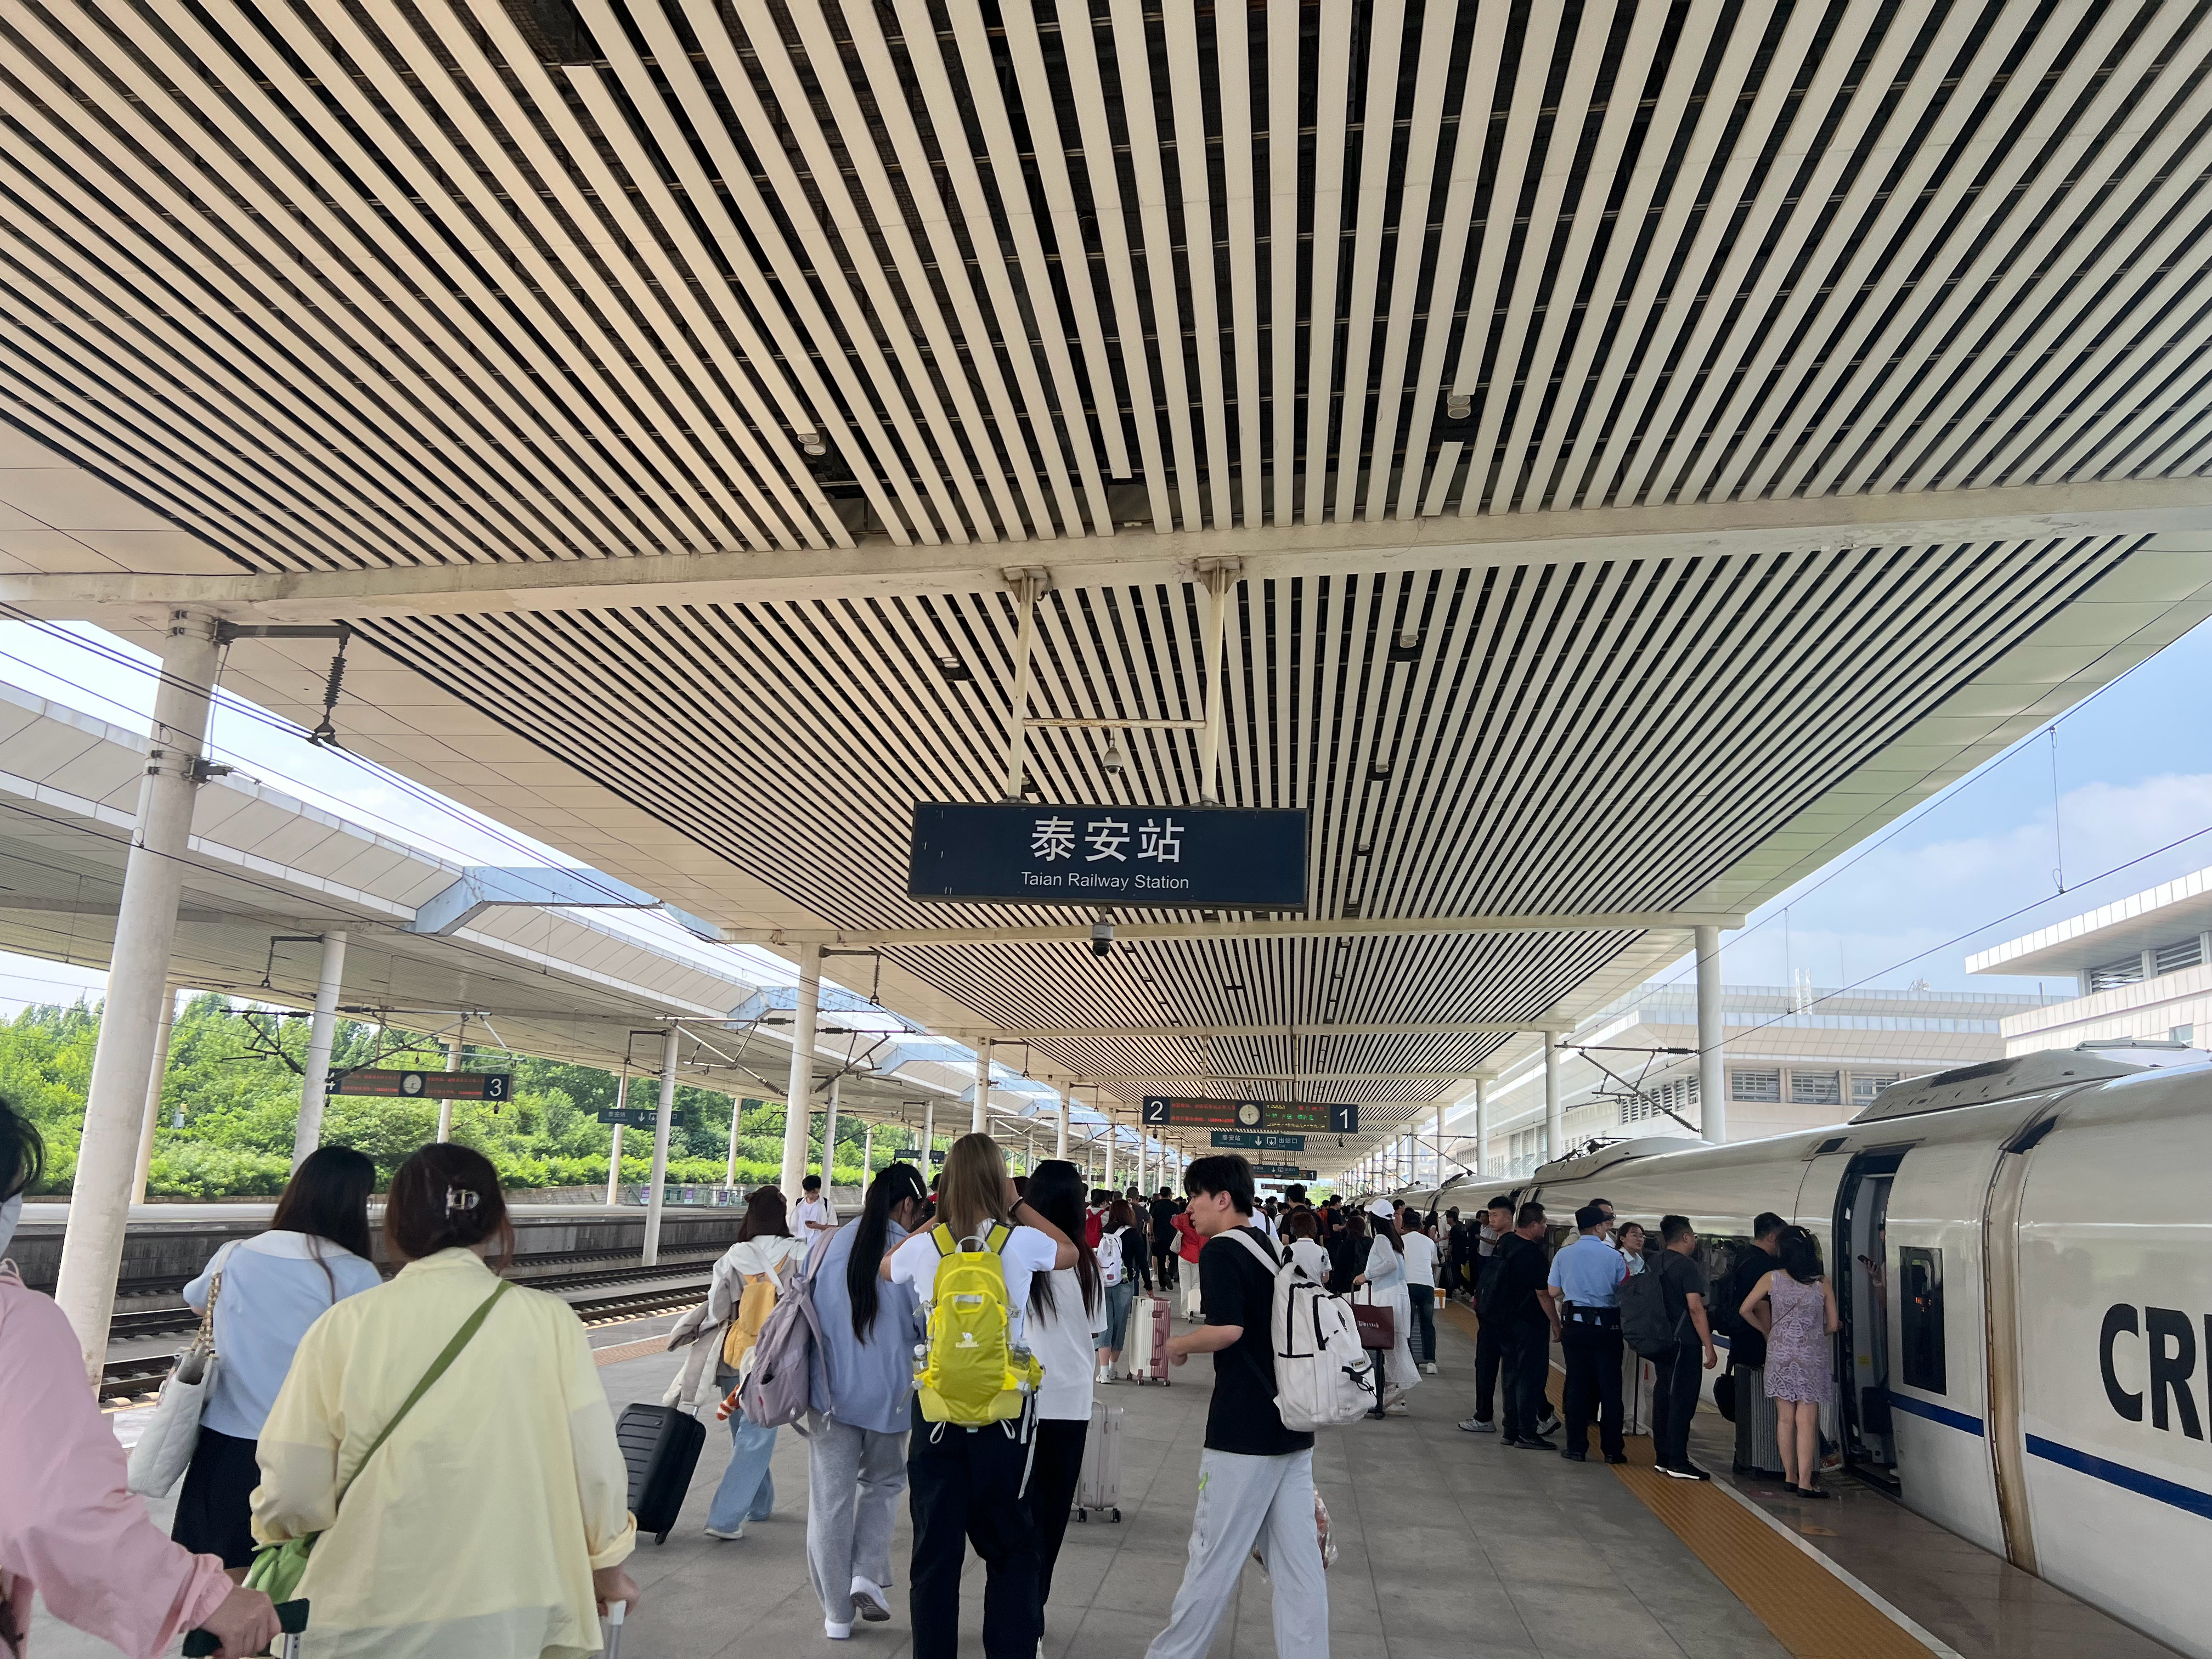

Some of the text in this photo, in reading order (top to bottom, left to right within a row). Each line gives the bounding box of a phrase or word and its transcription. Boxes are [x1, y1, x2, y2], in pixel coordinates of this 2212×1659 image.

[1030, 816, 1184, 863] 泰安站
[1021, 871, 1189, 891] Taian Railway Station
[489, 1078, 503, 1097] 3
[1150, 1101, 1163, 1121] 2
[1340, 1109, 1348, 1129] 1
[2100, 1303, 2212, 1444] CR
